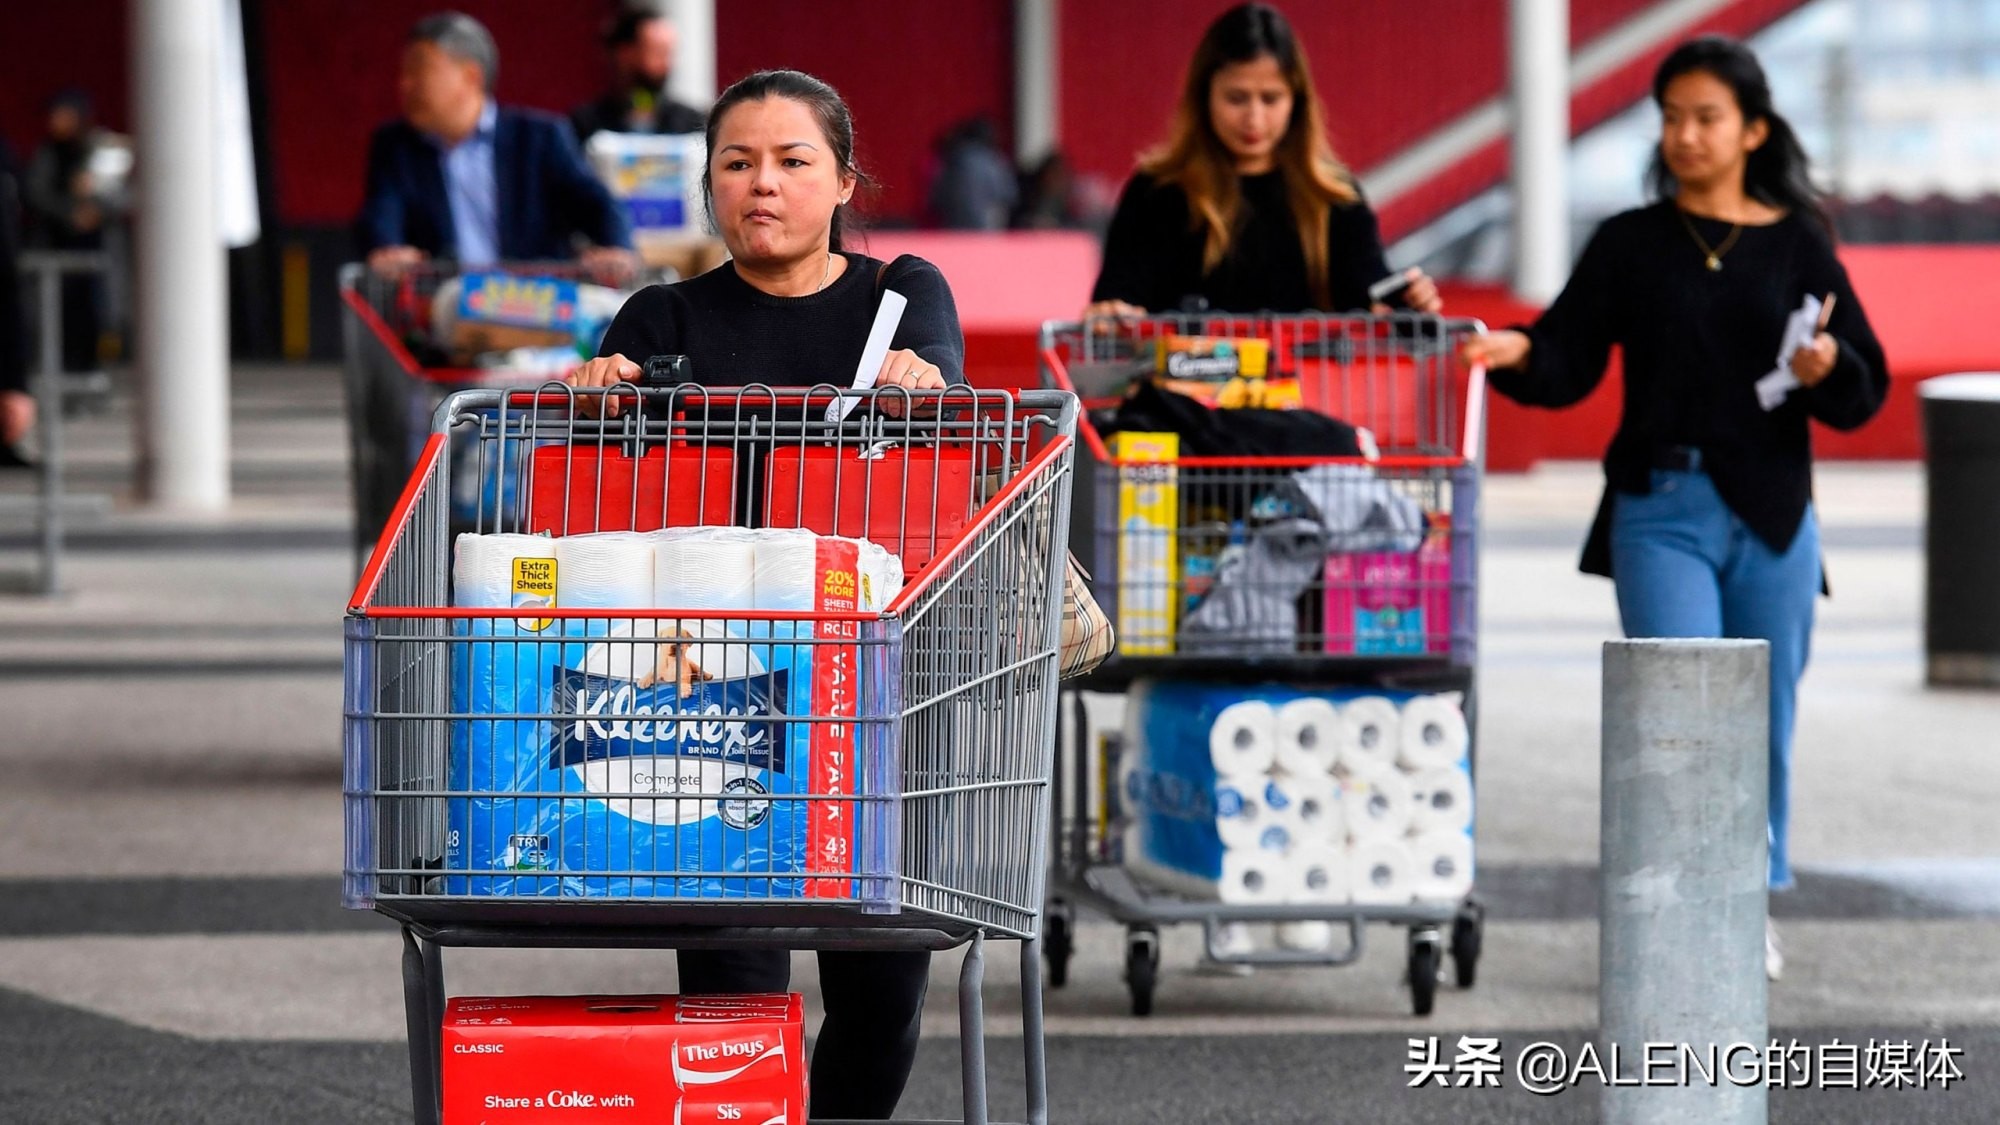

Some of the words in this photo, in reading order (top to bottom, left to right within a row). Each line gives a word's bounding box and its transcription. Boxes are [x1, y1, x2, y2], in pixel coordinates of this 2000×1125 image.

[521, 560, 550, 570] Extra
[520, 570, 550, 580] Thick
[824, 569, 855, 587] 20%
[516, 580, 553, 589] Sheets
[823, 585, 855, 598] MORE
[823, 598, 854, 610] SHEETS
[823, 622, 853, 637] ROLL
[830, 652, 847, 738] VALUE
[574, 685, 765, 756] Kleenex
[688, 746, 719, 755] BRAND
[731, 747, 748, 756] Toile
[634, 772, 701, 787] Compete
[828, 751, 844, 821] PACK
[516, 837, 540, 847] TRY
[453, 1044, 504, 1053] CLASSIC
[683, 1044, 719, 1062] The
[721, 1040, 765, 1057] boys
[484, 1094, 531, 1109] Share
[533, 1098, 545, 1109] a
[547, 1090, 594, 1109] Coke
[600, 1094, 635, 1108] with
[716, 1104, 742, 1120] Sis
